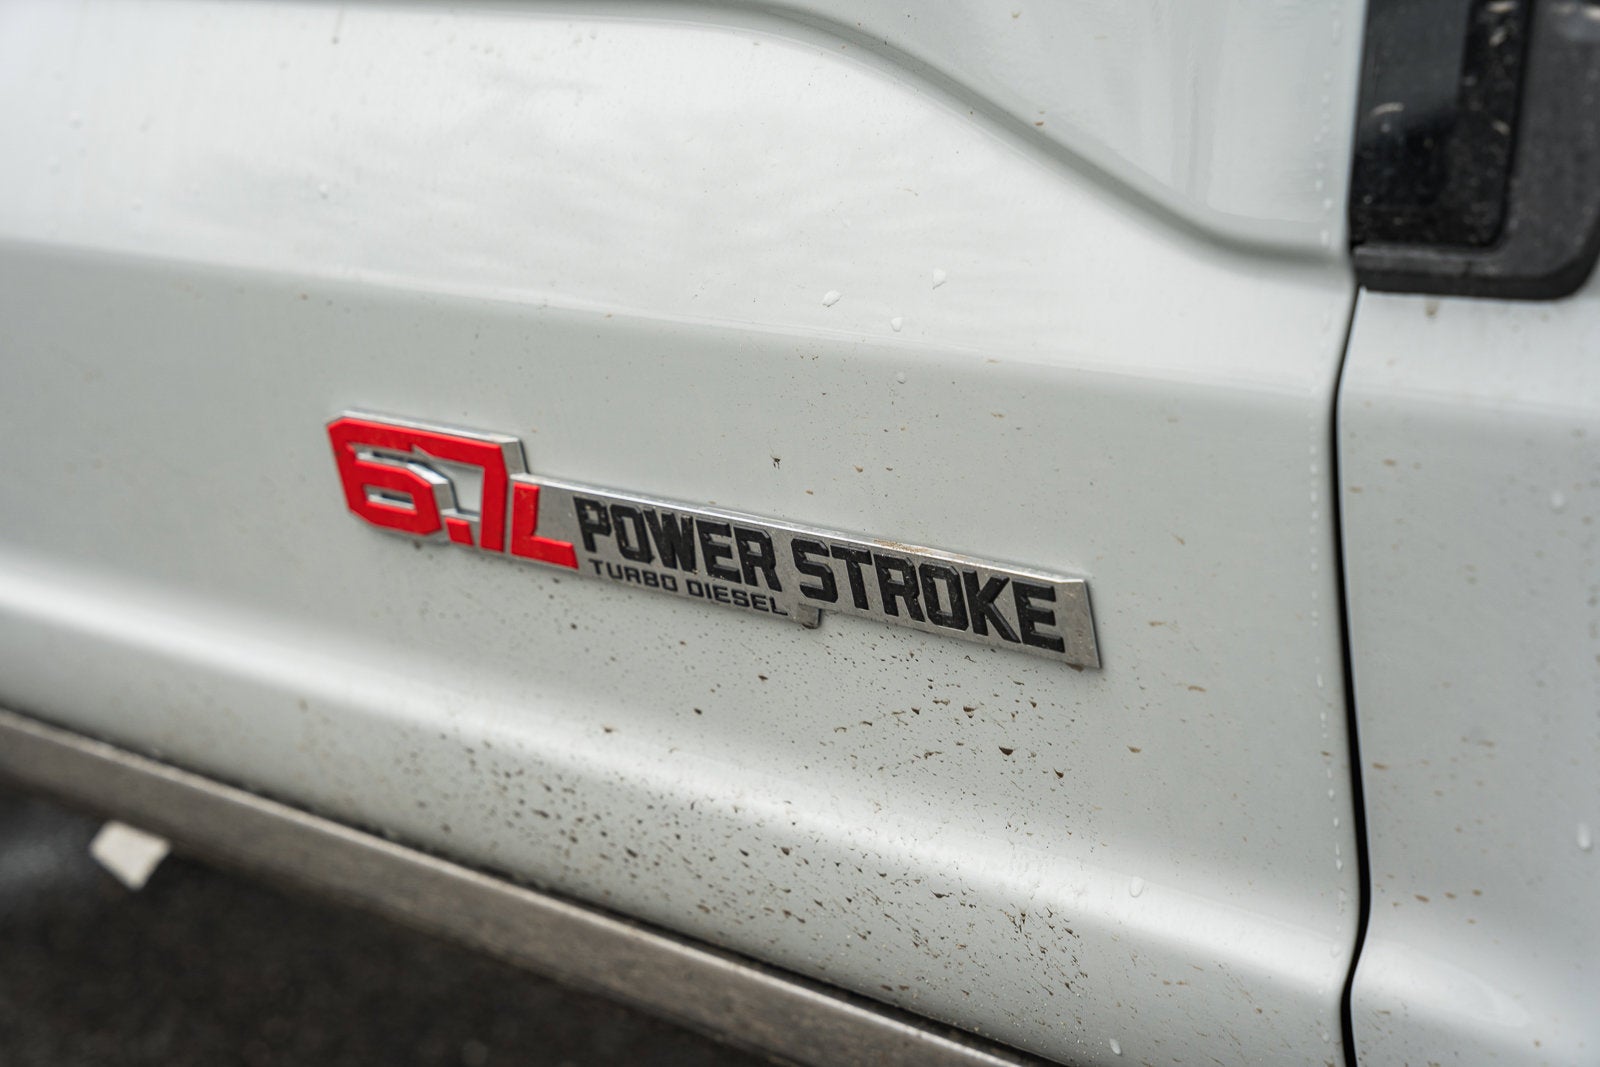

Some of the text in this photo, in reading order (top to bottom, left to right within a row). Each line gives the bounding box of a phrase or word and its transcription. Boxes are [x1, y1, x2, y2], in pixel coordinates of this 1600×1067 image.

[327, 416, 1066, 653] 6.7L POWER STROKE
[588, 558, 788, 616] TURBO DIESEL
